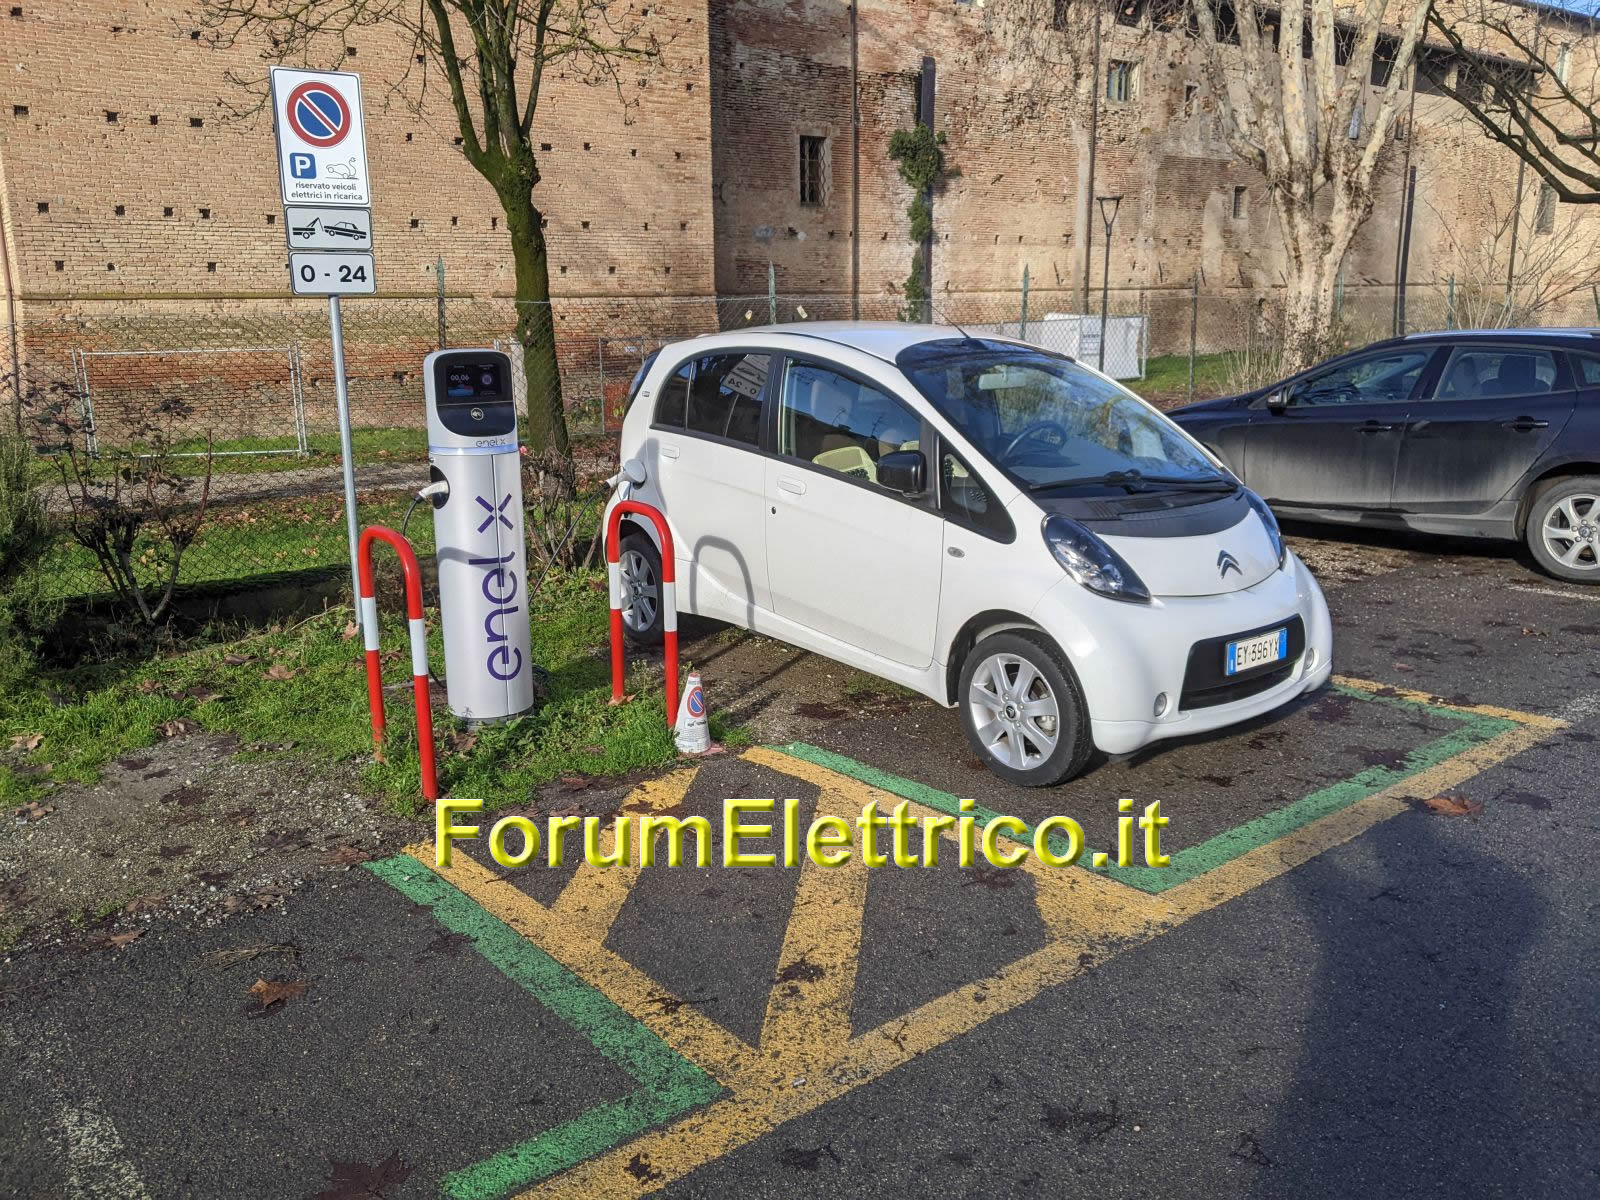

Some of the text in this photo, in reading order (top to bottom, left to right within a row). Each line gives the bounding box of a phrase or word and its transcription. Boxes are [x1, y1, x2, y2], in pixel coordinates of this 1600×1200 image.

[294, 155, 311, 177] P
[295, 181, 357, 191] riservato veicoli
[291, 190, 363, 200] elettrici in ricarica
[338, 264, 367, 283] 24
[475, 438, 499, 448] enel
[468, 551, 522, 681] enel
